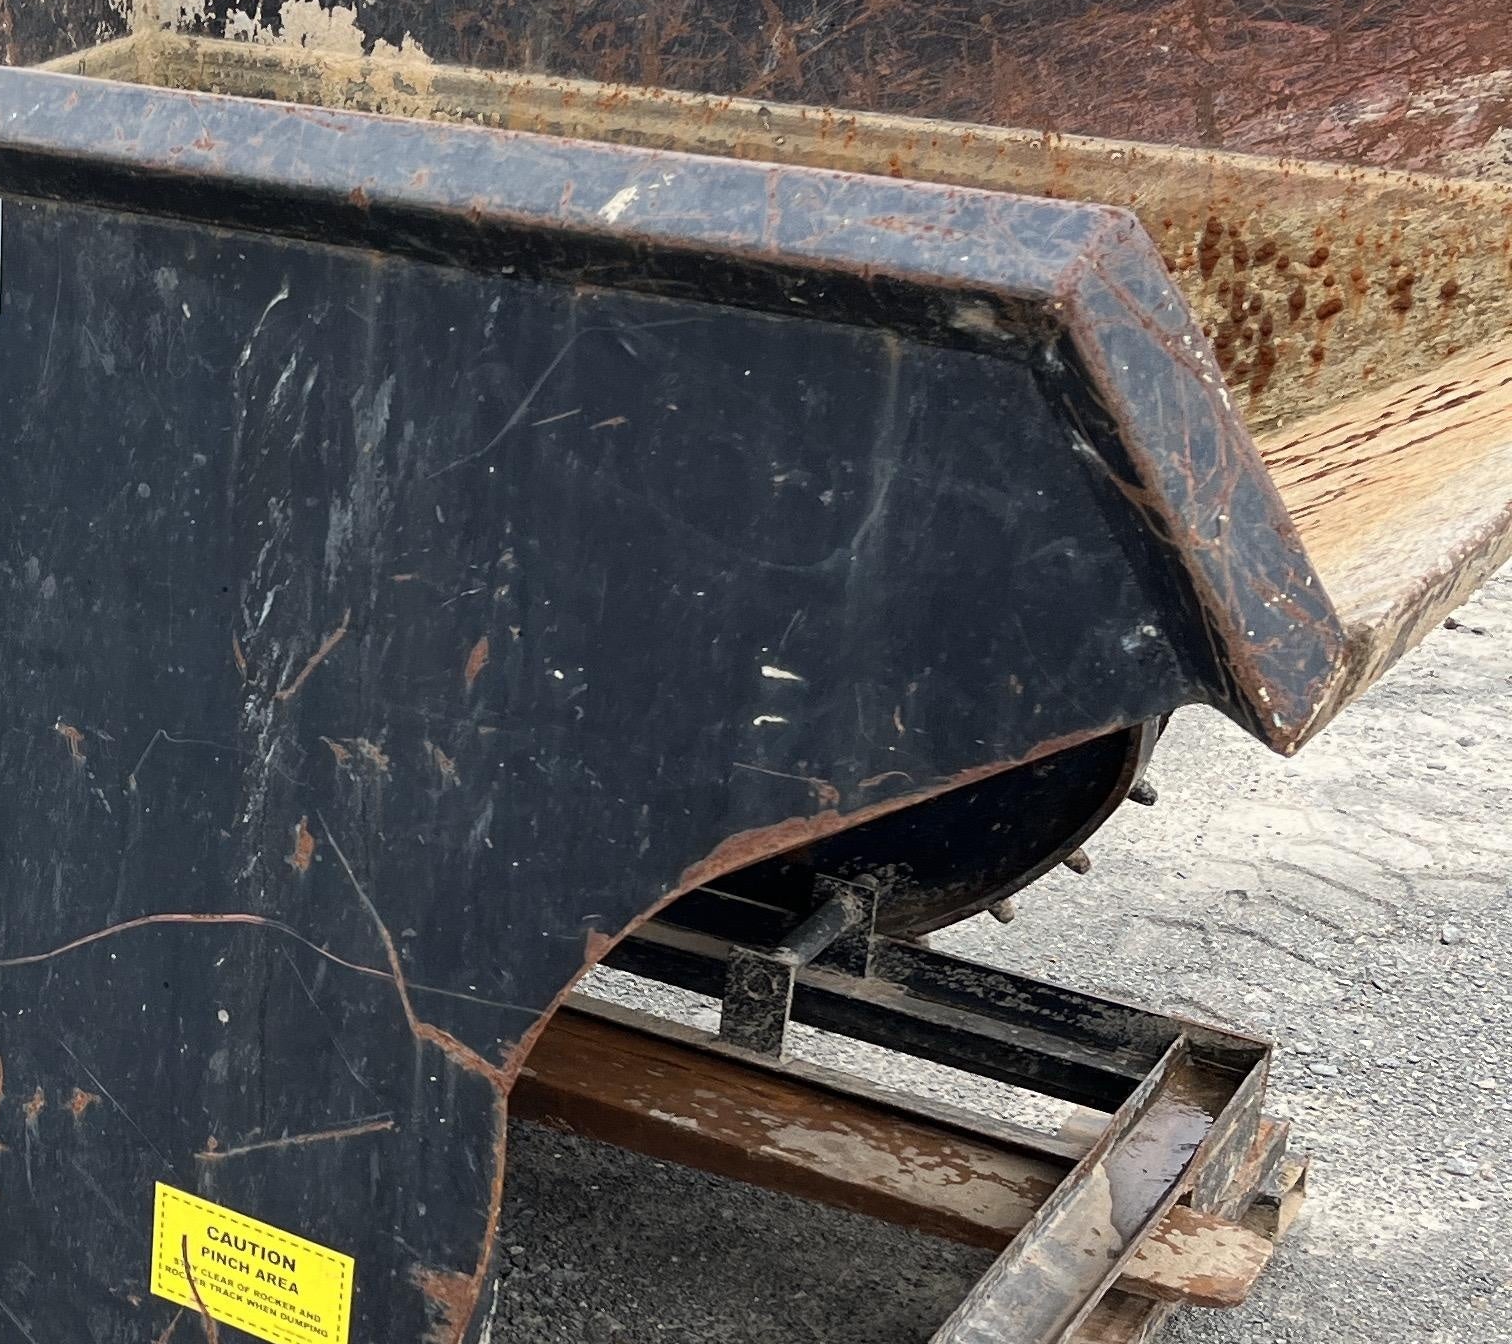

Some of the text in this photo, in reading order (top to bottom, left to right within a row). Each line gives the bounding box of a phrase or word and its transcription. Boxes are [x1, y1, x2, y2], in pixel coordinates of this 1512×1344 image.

[201, 1246, 300, 1296] PINCH AREA
[206, 1225, 297, 1273] CAUTION
[173, 1256, 322, 1324] STY CLEAR OF ROCKER AND
[208, 1282, 245, 1304] TRACK
[246, 1298, 278, 1318] WHEN
[280, 1311, 329, 1338] DUMPING
